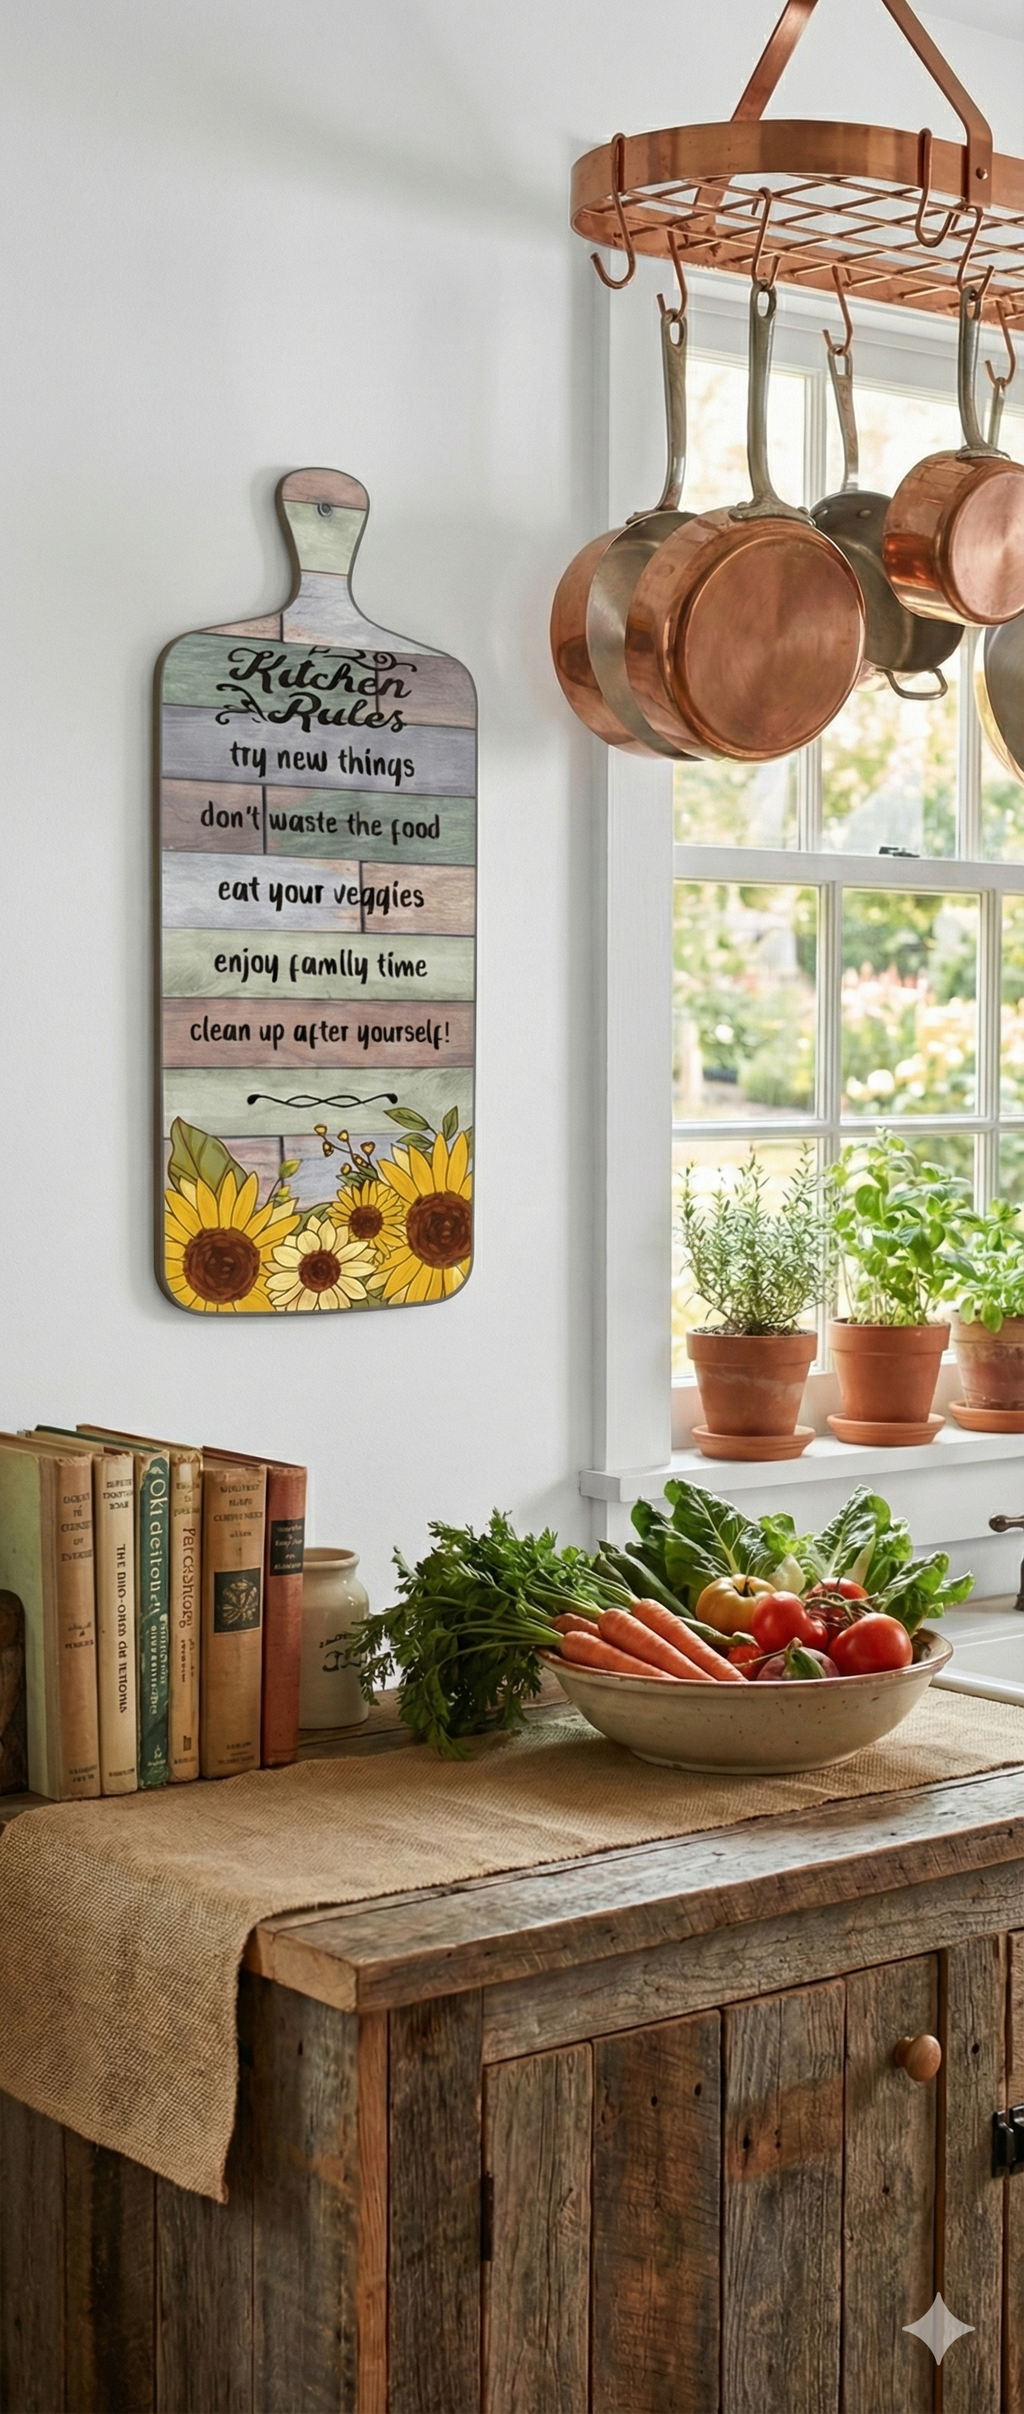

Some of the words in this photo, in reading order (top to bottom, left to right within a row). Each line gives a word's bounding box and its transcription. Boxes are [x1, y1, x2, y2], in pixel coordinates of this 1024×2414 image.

[227, 646, 413, 699] Kitchen
[266, 691, 408, 733] Rules
[229, 740, 267, 779] try
[277, 749, 328, 772] new
[337, 745, 415, 787] things
[200, 800, 260, 831] don't
[268, 810, 338, 834] waste
[346, 810, 383, 837] the
[391, 814, 440, 846] food
[218, 876, 260, 902] eat
[269, 882, 324, 912] your
[334, 880, 425, 916] veggies
[214, 947, 279, 983] enjoy
[377, 951, 428, 978] time
[190, 1015, 251, 1042] clean
[259, 1022, 285, 1051] up
[293, 1020, 349, 1050] after
[357, 1018, 451, 1051] yourself!
